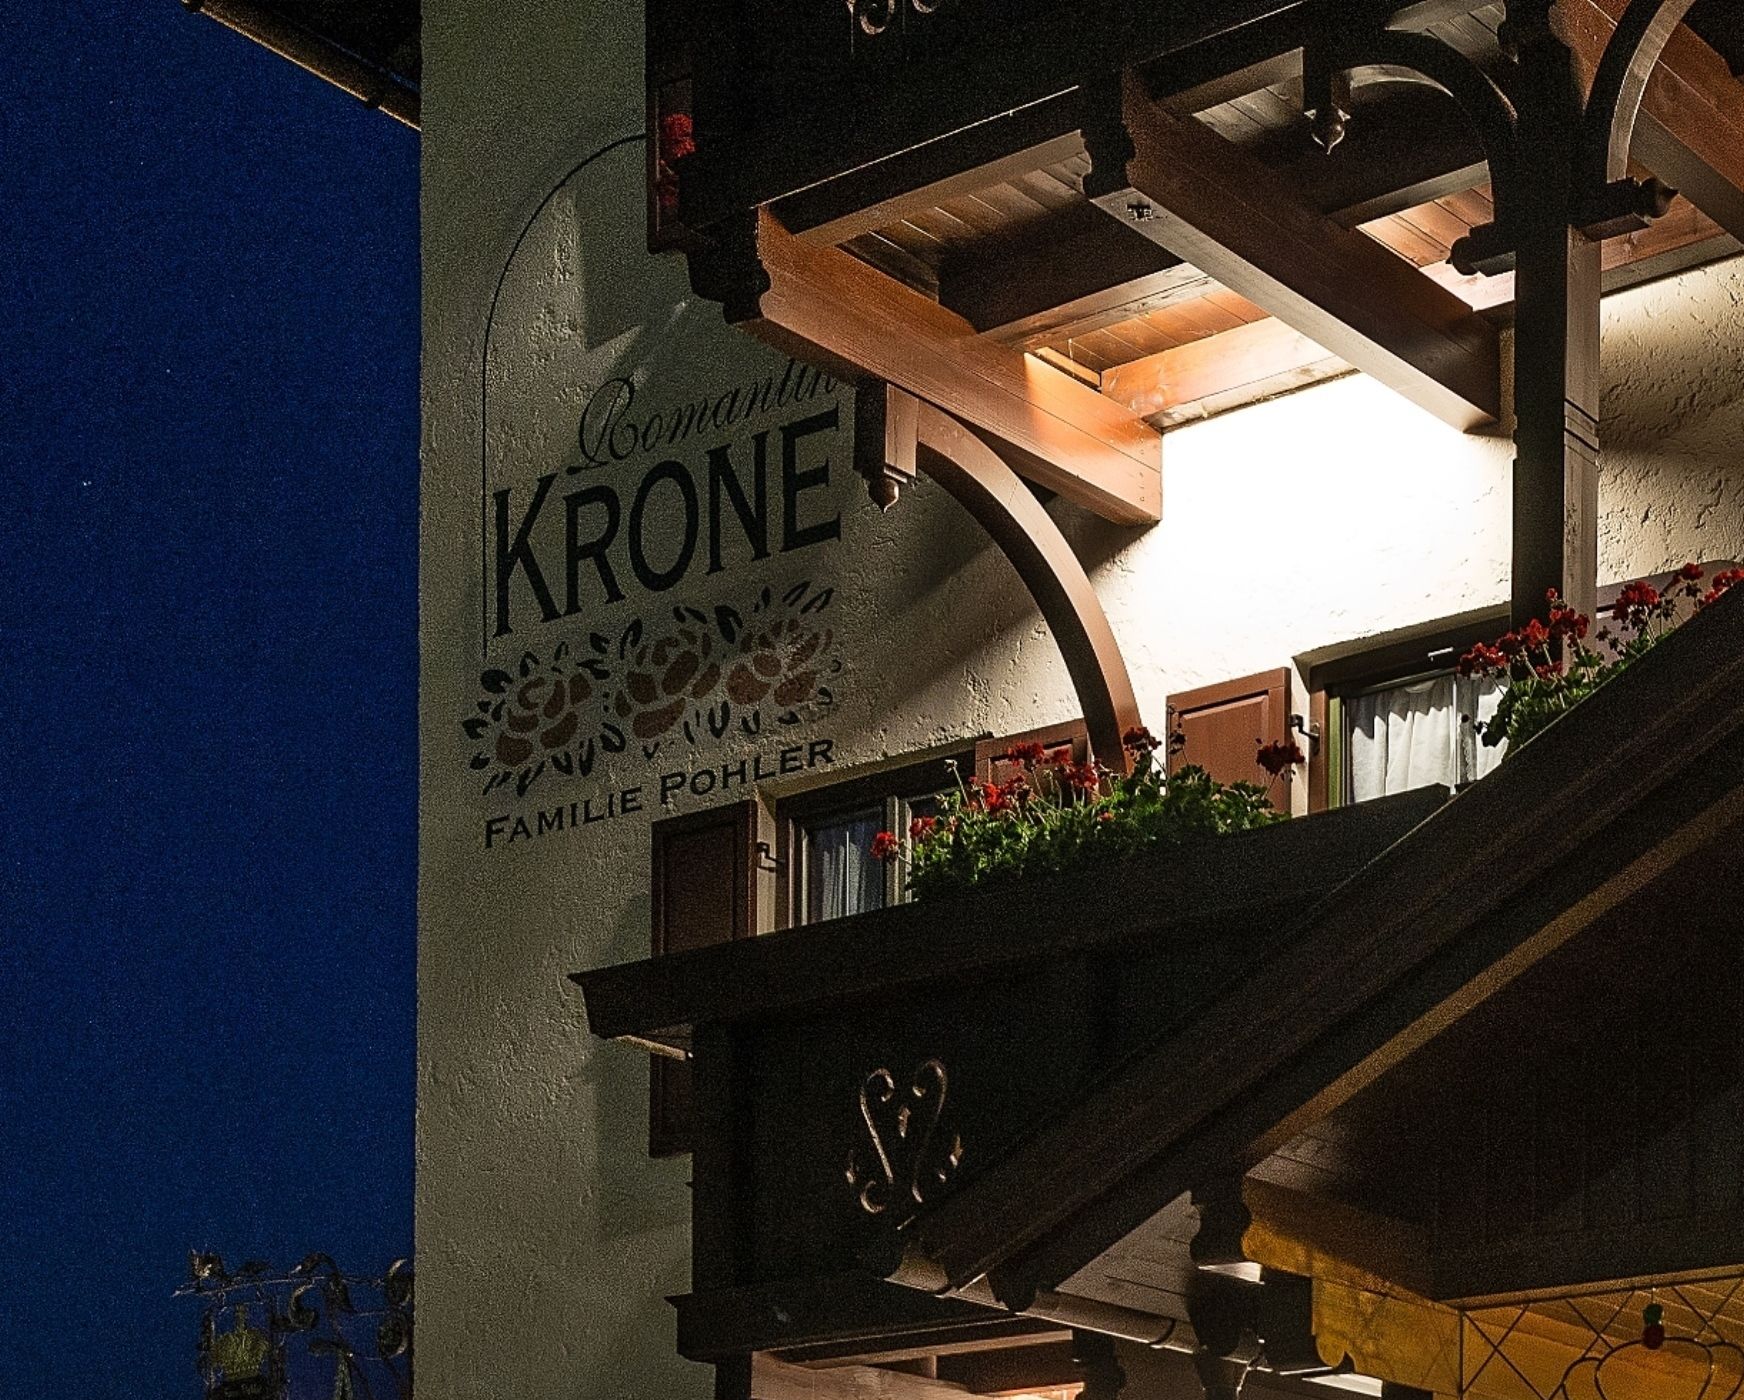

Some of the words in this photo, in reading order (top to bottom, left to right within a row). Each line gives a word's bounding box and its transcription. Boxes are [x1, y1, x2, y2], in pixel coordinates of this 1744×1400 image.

[491, 402, 842, 638] KRONE
[484, 785, 642, 849] FAMILIE
[658, 737, 836, 802] POHLER
